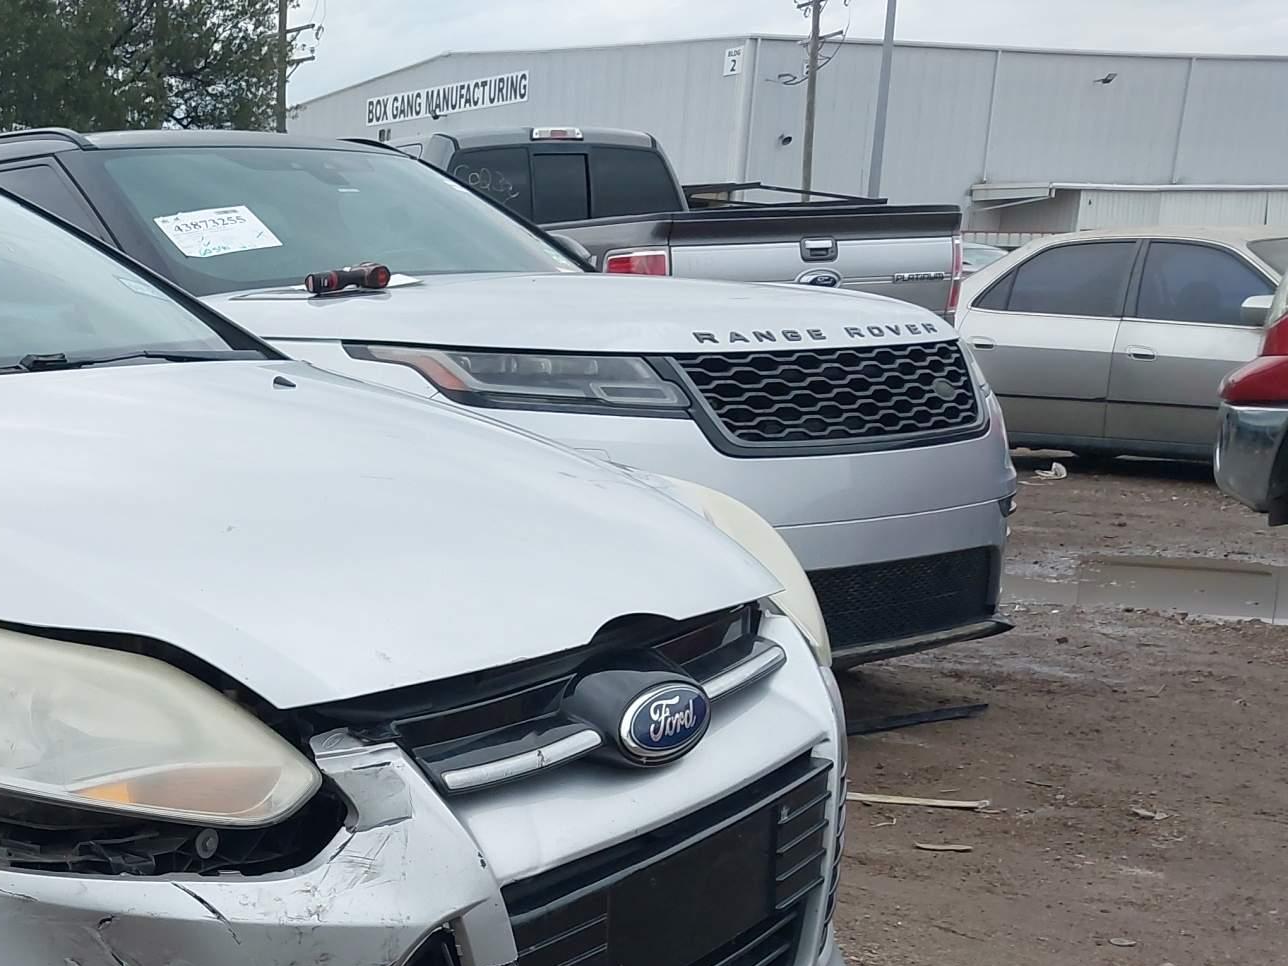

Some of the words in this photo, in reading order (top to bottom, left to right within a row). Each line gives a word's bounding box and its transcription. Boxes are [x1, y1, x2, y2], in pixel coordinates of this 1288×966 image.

[730, 59, 737, 72] 2
[367, 98, 389, 124] BOX
[391, 92, 422, 120] GANG
[425, 73, 527, 115] MANUFACTURING
[174, 215, 247, 233] 43873255
[895, 272, 945, 282] PLATINUM
[693, 328, 827, 344] RANGE
[844, 322, 939, 339] ROVER
[649, 695, 697, 742] Ford
